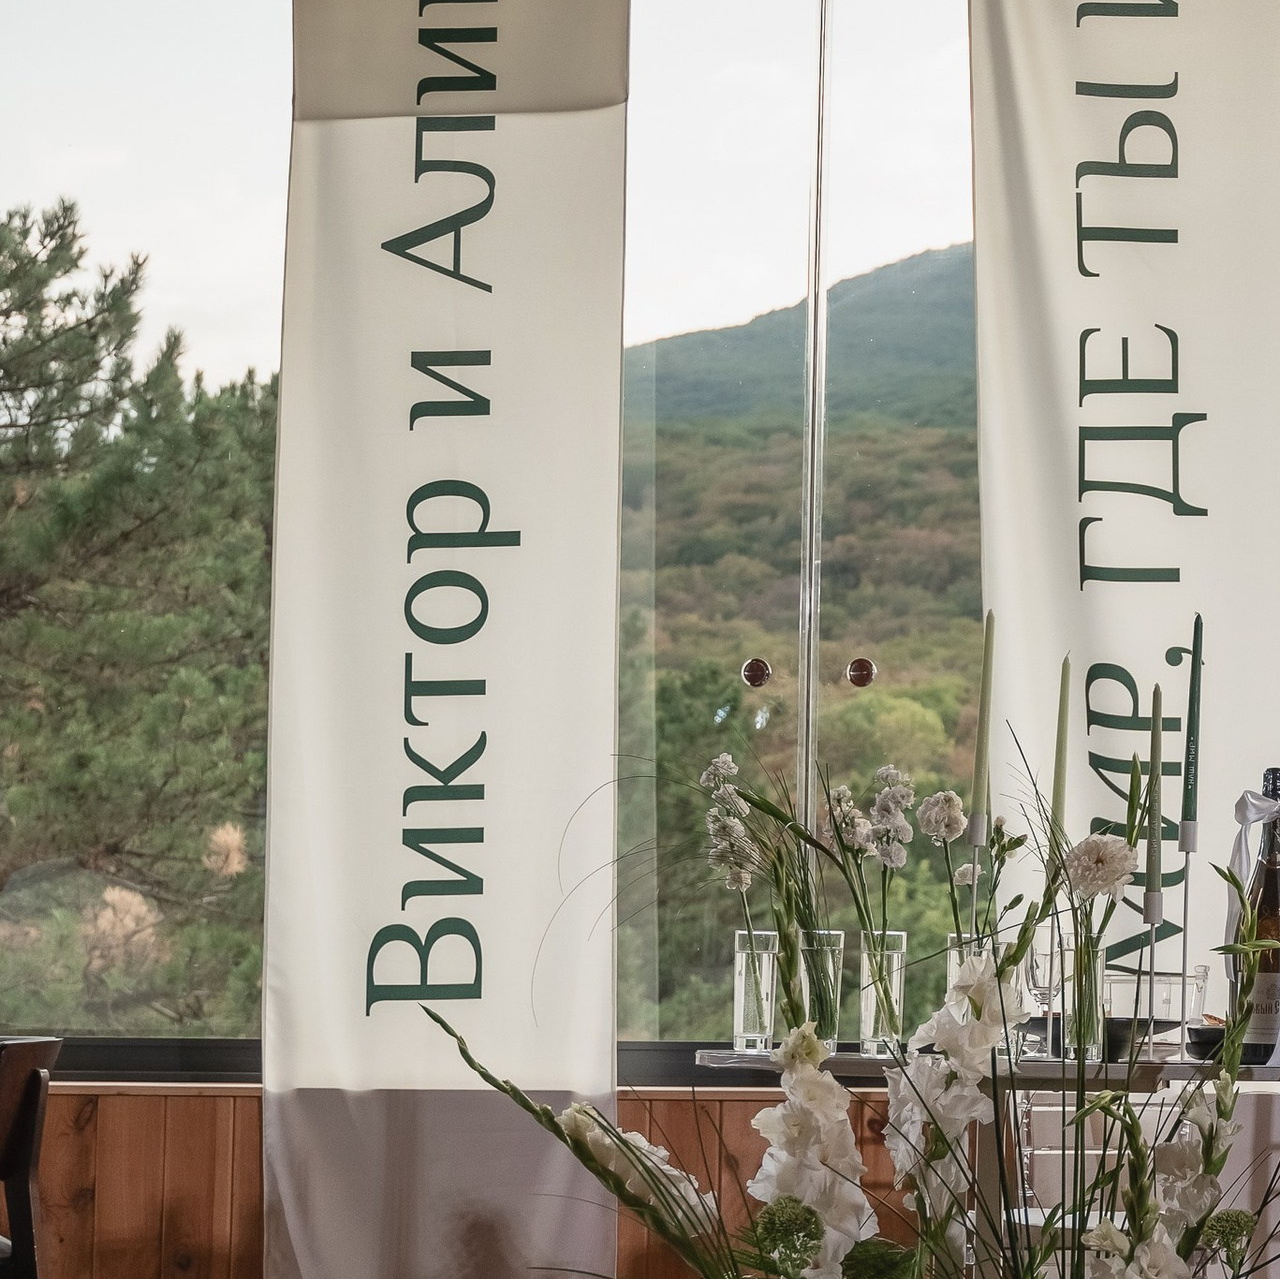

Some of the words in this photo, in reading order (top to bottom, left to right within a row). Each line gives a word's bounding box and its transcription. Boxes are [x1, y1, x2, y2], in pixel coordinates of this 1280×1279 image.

[1076, 72, 1178, 276] ТЫ
[409, 351, 492, 430] и
[1078, 324, 1208, 591] ГДЕ
[366, 480, 520, 1016] Виктор
[1188, 741, 1196, 762] МИР
